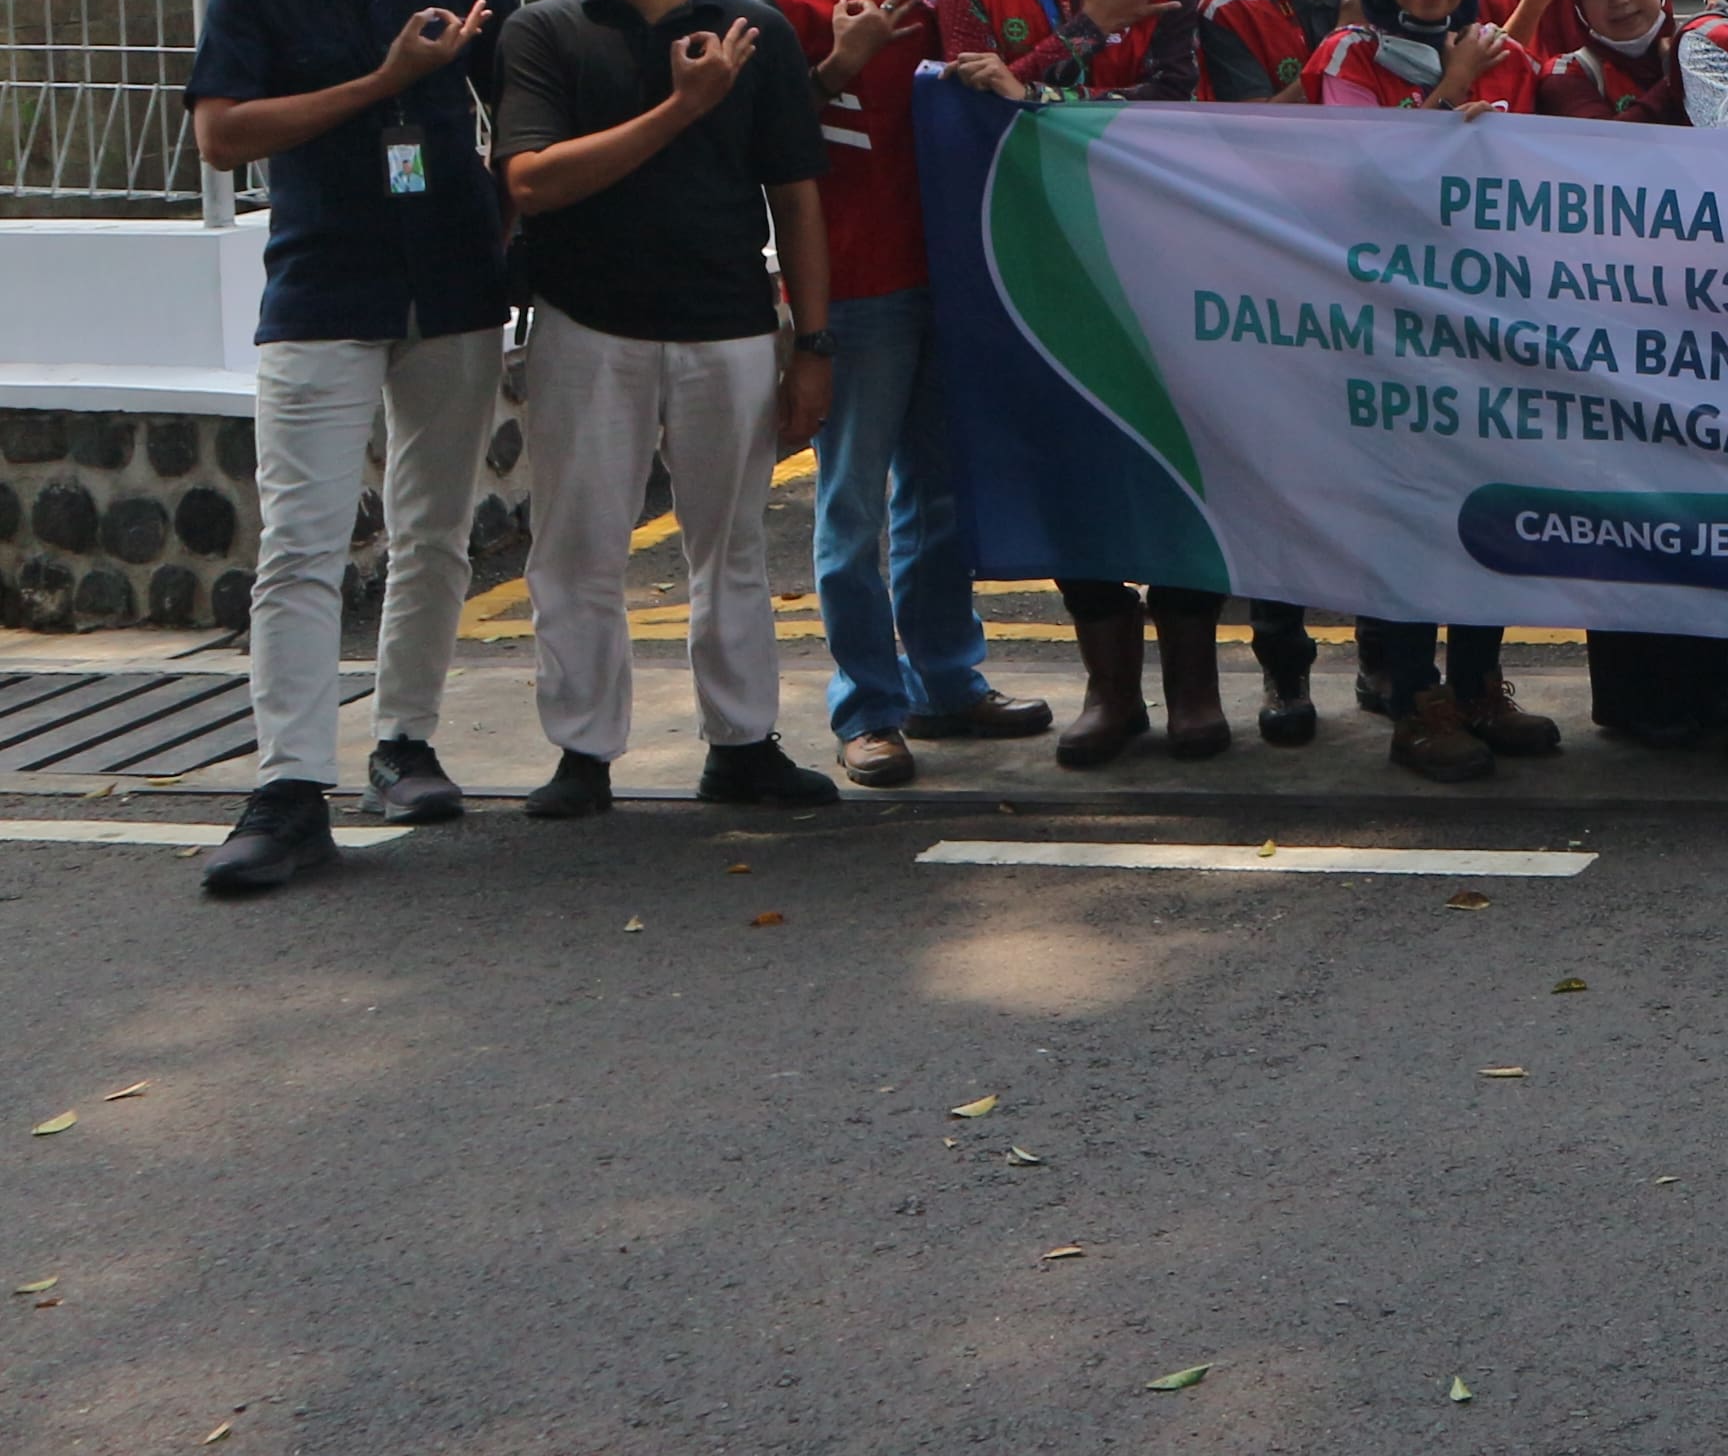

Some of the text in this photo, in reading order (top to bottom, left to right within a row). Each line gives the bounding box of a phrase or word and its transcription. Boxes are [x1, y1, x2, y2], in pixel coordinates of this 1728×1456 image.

[1347, 242, 1532, 300] CALON
[1548, 260, 1666, 307] AHLI
[1194, 290, 1374, 356] DALAM
[1396, 310, 1619, 373] RANGKA
[1348, 378, 1460, 435] BPJS
[1515, 511, 1682, 555] CABANG
